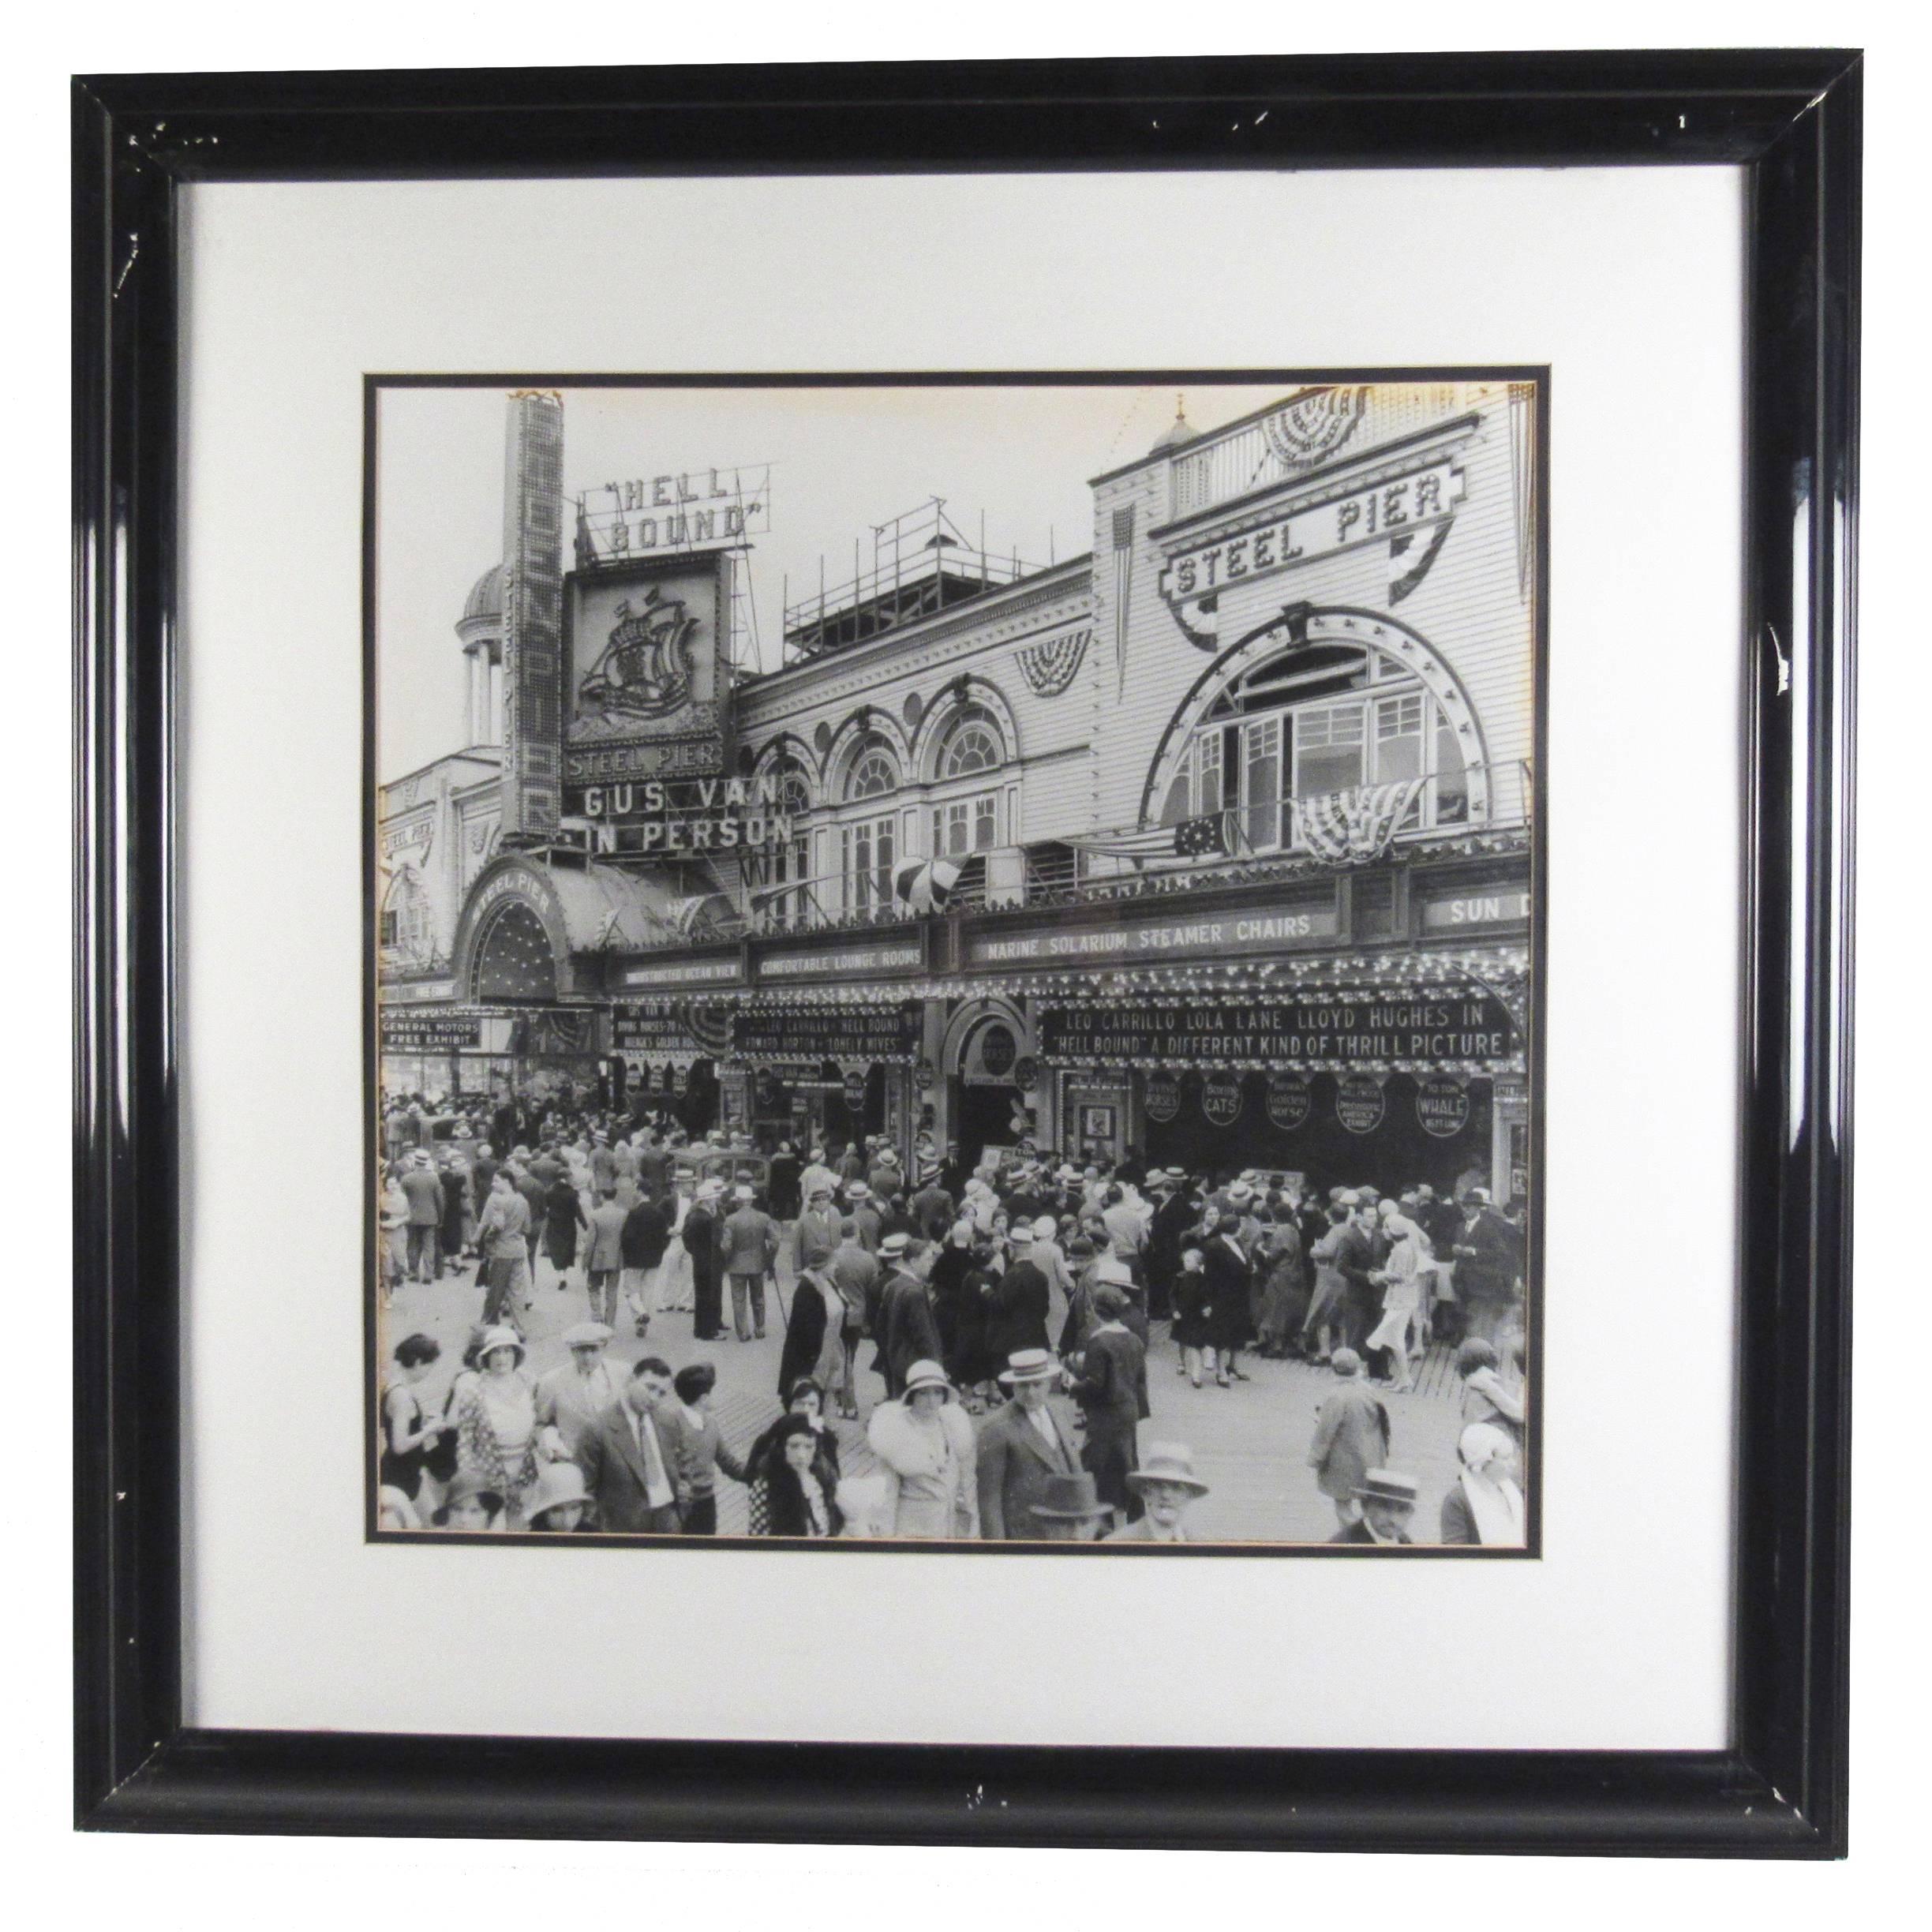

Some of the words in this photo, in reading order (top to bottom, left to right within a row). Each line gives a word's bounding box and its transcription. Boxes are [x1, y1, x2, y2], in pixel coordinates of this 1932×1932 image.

[1178, 524, 1303, 593] STEEL
[1337, 474, 1441, 542] PIER
[568, 750, 644, 777] STEEL
[657, 743, 715, 769] PIER
[585, 781, 664, 816] GUS
[698, 775, 777, 808] VAN
[585, 824, 618, 854] IN
[642, 815, 794, 852] PERSON
[517, 873, 549, 915] PIER
[1451, 897, 1500, 923] SUN
[988, 939, 1039, 960] MARINE
[1050, 932, 1127, 954] SOLARIUM
[1139, 923, 1222, 949] STEAMER
[1236, 915, 1311, 940] CHAIRS
[833, 953, 876, 970] LOUNGE
[882, 949, 921, 967] ROOMS
[382, 1021, 432, 1032] GENERAL
[436, 1022, 479, 1033] MOTORS
[1066, 1013, 1091, 1030] LEO
[1102, 1012, 1175, 1030] CARRILLO
[1186, 1011, 1223, 1030] LOLA
[1237, 1010, 1282, 1030] LANE
[1298, 1008, 1355, 1029] LLOYD
[1370, 1005, 1449, 1028] HUGHES
[1463, 1003, 1484, 1025] IN
[390, 1034, 420, 1044] FREE
[425, 1035, 471, 1045] EXHIBIT
[1053, 1035, 1090, 1054] "HELL
[1093, 1035, 1147, 1054] BOUND"
[1151, 1035, 1160, 1054] A
[1167, 1035, 1253, 1054] DIFFERENT
[1260, 1035, 1301, 1055] KIND
[1306, 1035, 1328, 1055] OF
[1337, 1035, 1404, 1055] THRILL
[1411, 1032, 1503, 1056] PICTURE
[1204, 1099, 1237, 1113] CATS
[1420, 1098, 1464, 1117] WHALE
